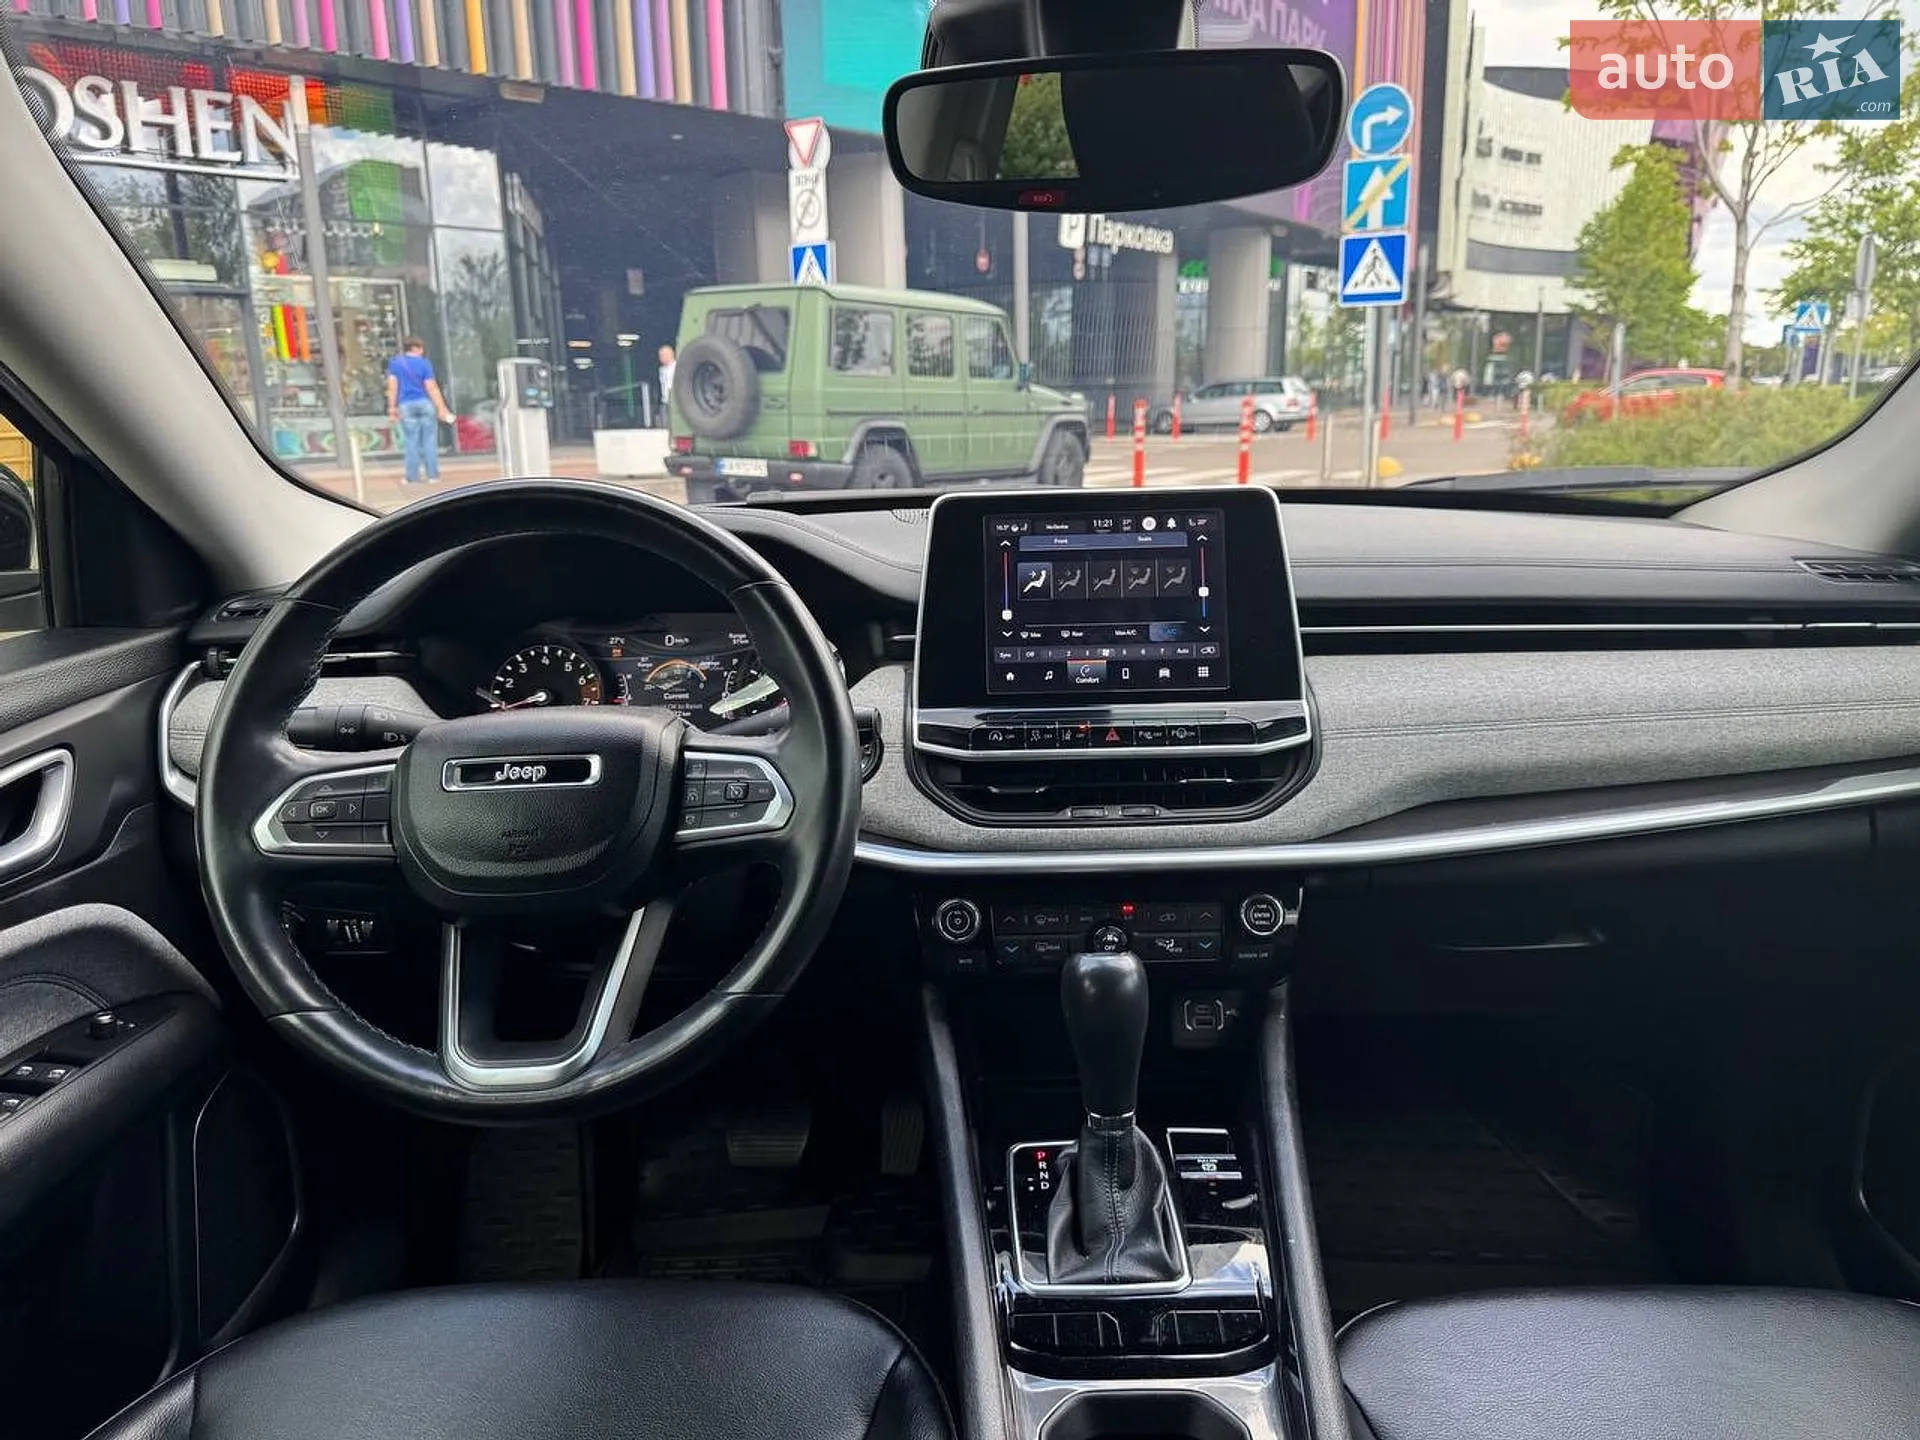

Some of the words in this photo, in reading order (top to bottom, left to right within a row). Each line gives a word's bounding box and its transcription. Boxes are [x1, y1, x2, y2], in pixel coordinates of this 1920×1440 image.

[1088, 213, 1175, 255] Парковка
[1093, 519, 1113, 528] 11:21
[664, 634, 675, 647] 0
[541, 656, 550, 665] 4
[519, 663, 528, 673] 3
[564, 662, 572, 672] 5
[505, 678, 514, 688] 2
[578, 675, 586, 685] 6
[663, 692, 690, 700] Current
[495, 763, 547, 782] Jeep
[316, 805, 329, 813] OK
[1037, 1151, 1046, 1160] P
[1039, 1161, 1047, 1170] R
[1040, 1171, 1049, 1180] N
[1041, 1181, 1050, 1190] D
